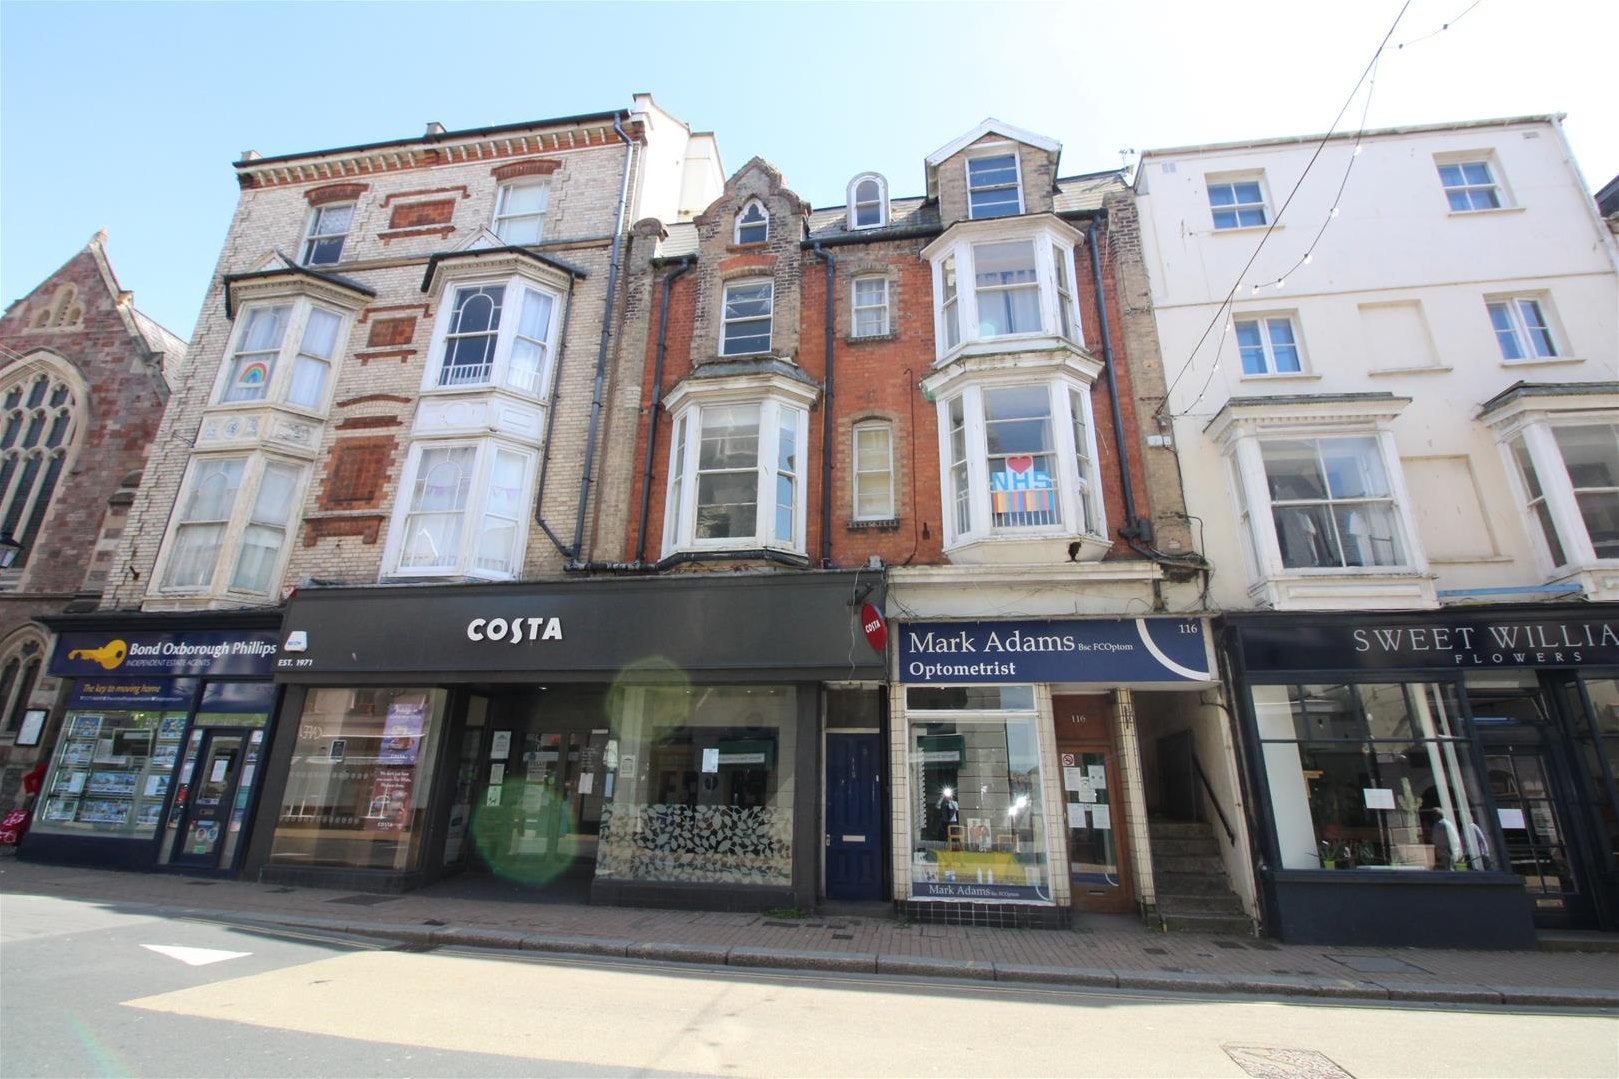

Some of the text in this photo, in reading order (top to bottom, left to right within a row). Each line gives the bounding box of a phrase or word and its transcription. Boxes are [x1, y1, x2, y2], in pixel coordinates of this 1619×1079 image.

[992, 470, 1052, 491] NHS
[466, 617, 563, 644] COSTA
[865, 619, 881, 634] COSTA
[1178, 624, 1198, 634] 116
[909, 630, 1133, 653] Mark Adams Bsc FCOptom
[1353, 627, 1475, 652] SWEET
[129, 641, 277, 658] Bond Oxborough Phillips
[126, 659, 211, 667] INDEPENDENT ESTATE AGENTS
[278, 659, 313, 667] EST. 1971
[1455, 652, 1582, 664] FLOWERS
[909, 661, 1016, 679] Optometrist
[83, 684, 161, 695] The key to moving home
[1071, 715, 1086, 723] 116
[929, 885, 955, 895] Mark
[957, 885, 991, 896] Adams
